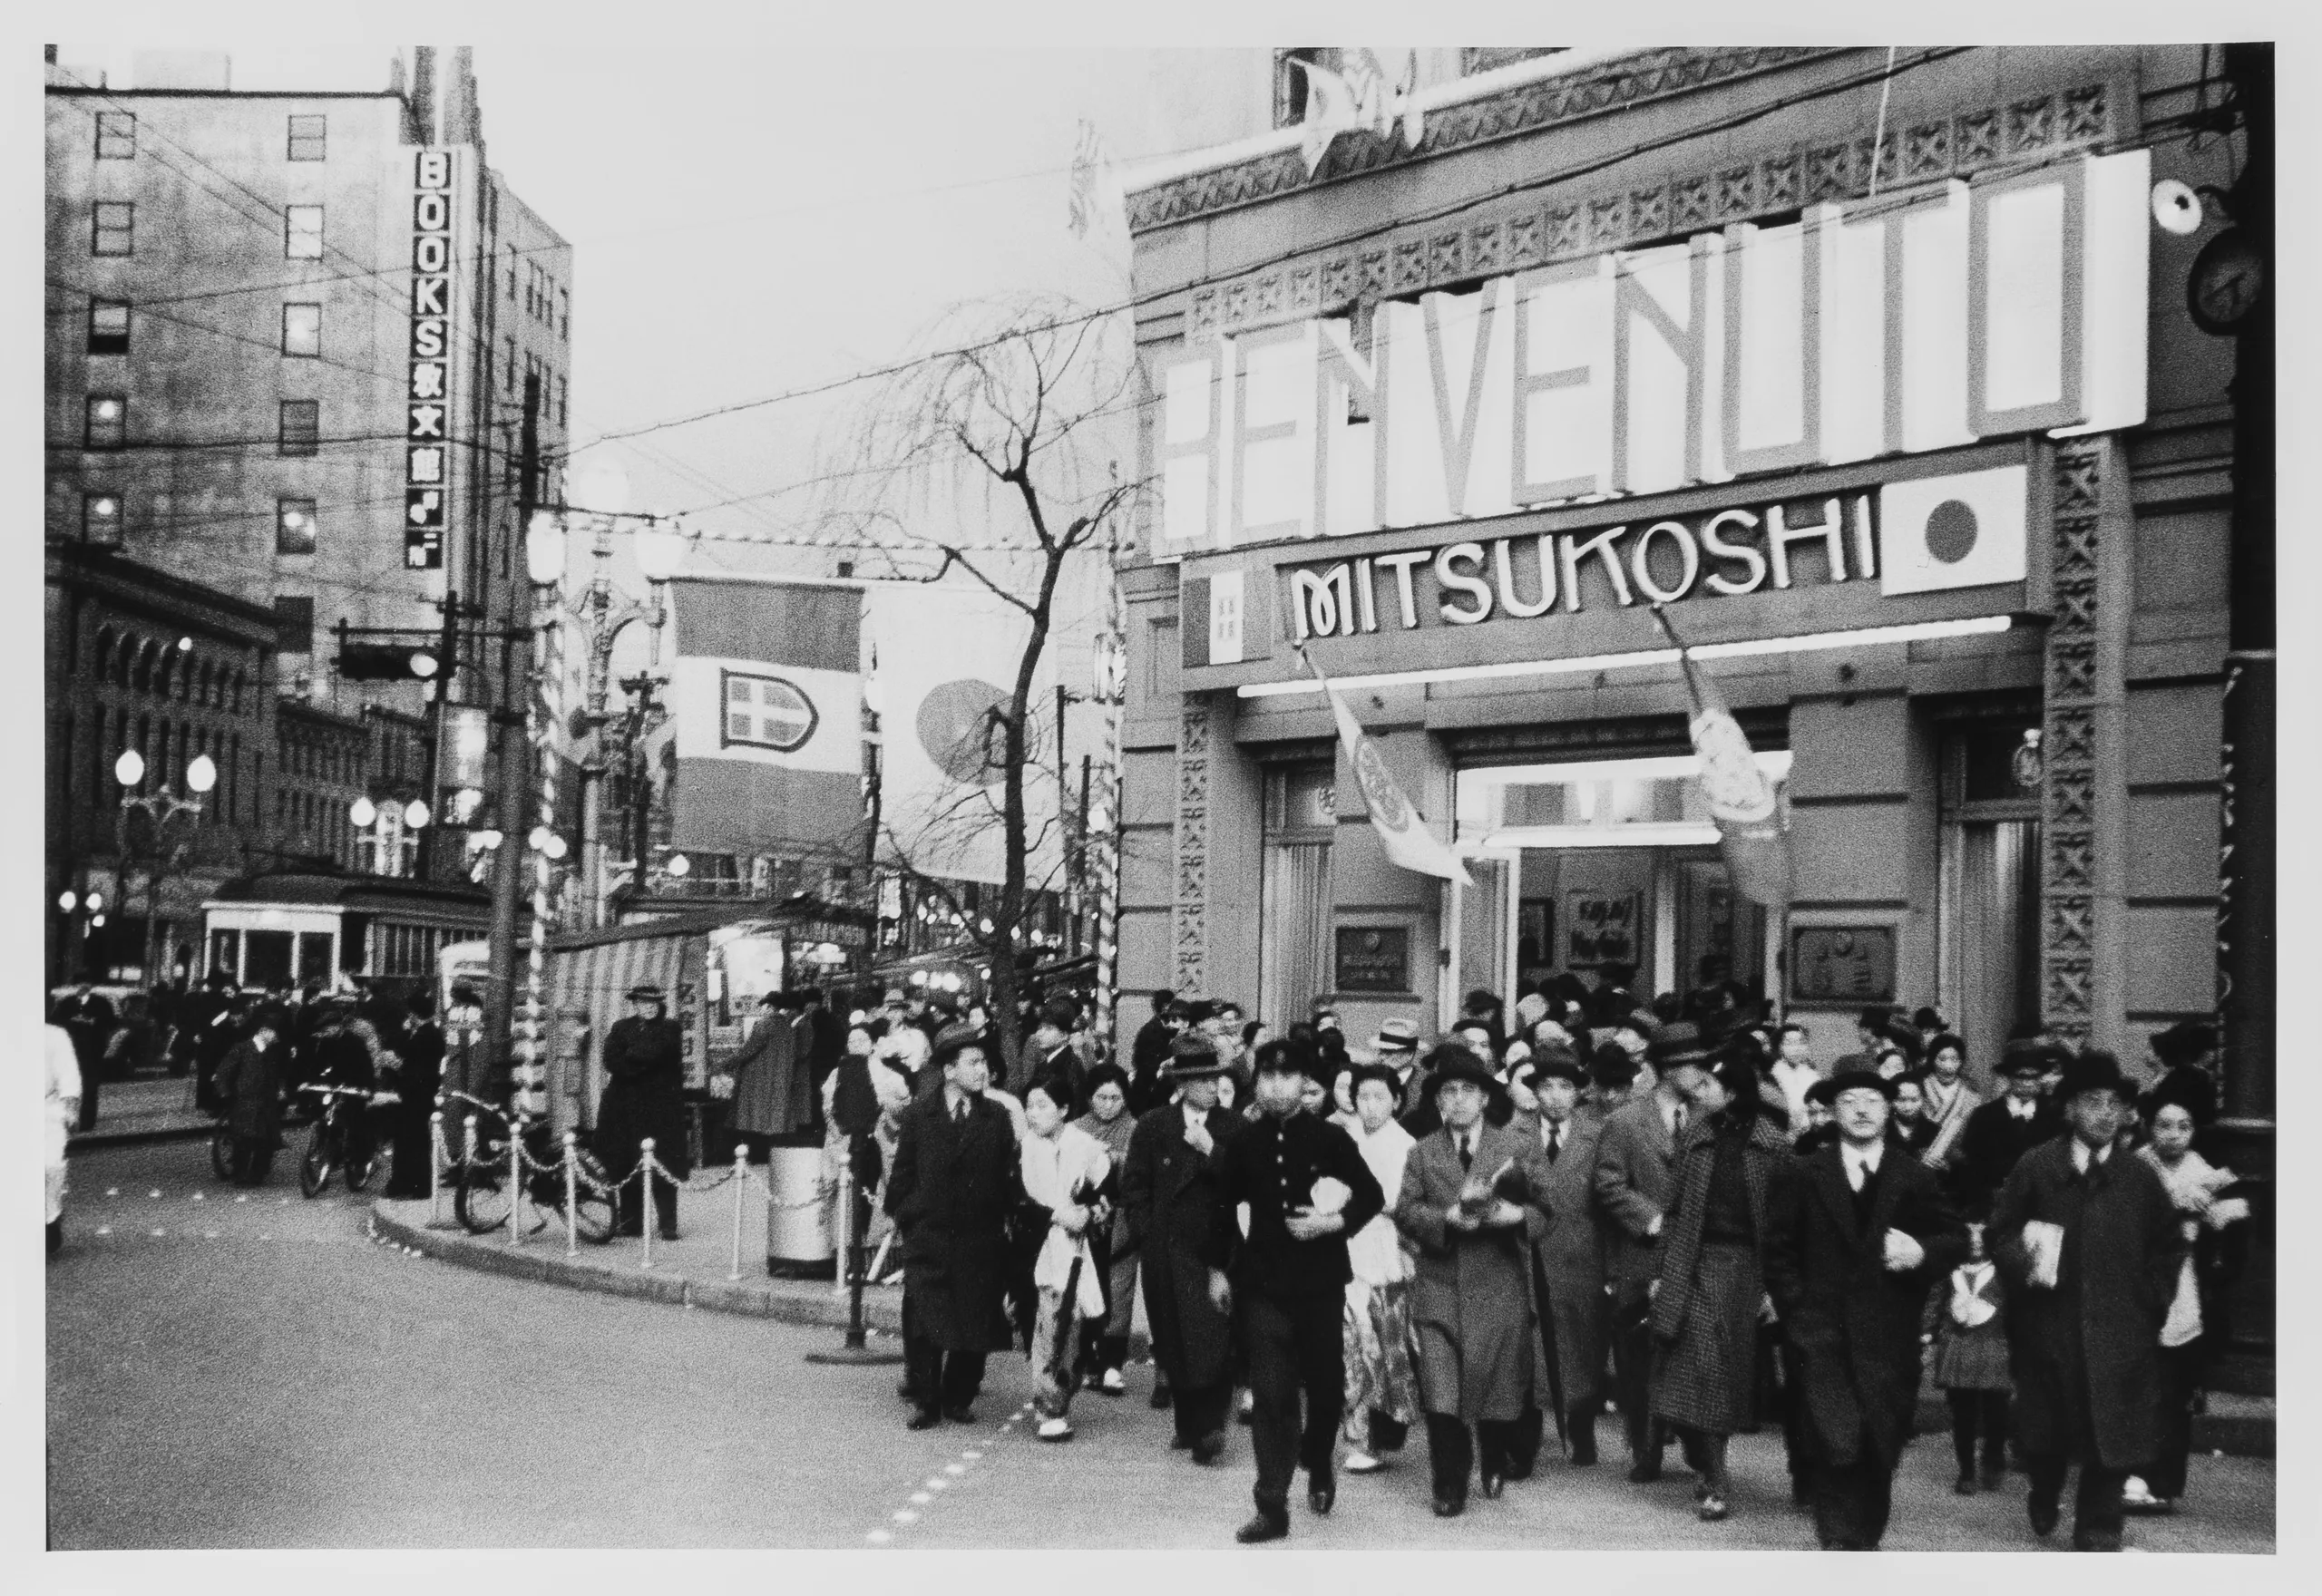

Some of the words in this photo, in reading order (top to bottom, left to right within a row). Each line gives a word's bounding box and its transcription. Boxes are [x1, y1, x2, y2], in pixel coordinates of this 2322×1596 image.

[415, 153, 446, 356] BOOKS
[1150, 156, 2090, 560] BENVENUTO
[1291, 495, 1876, 639] MITSUKOSHI
